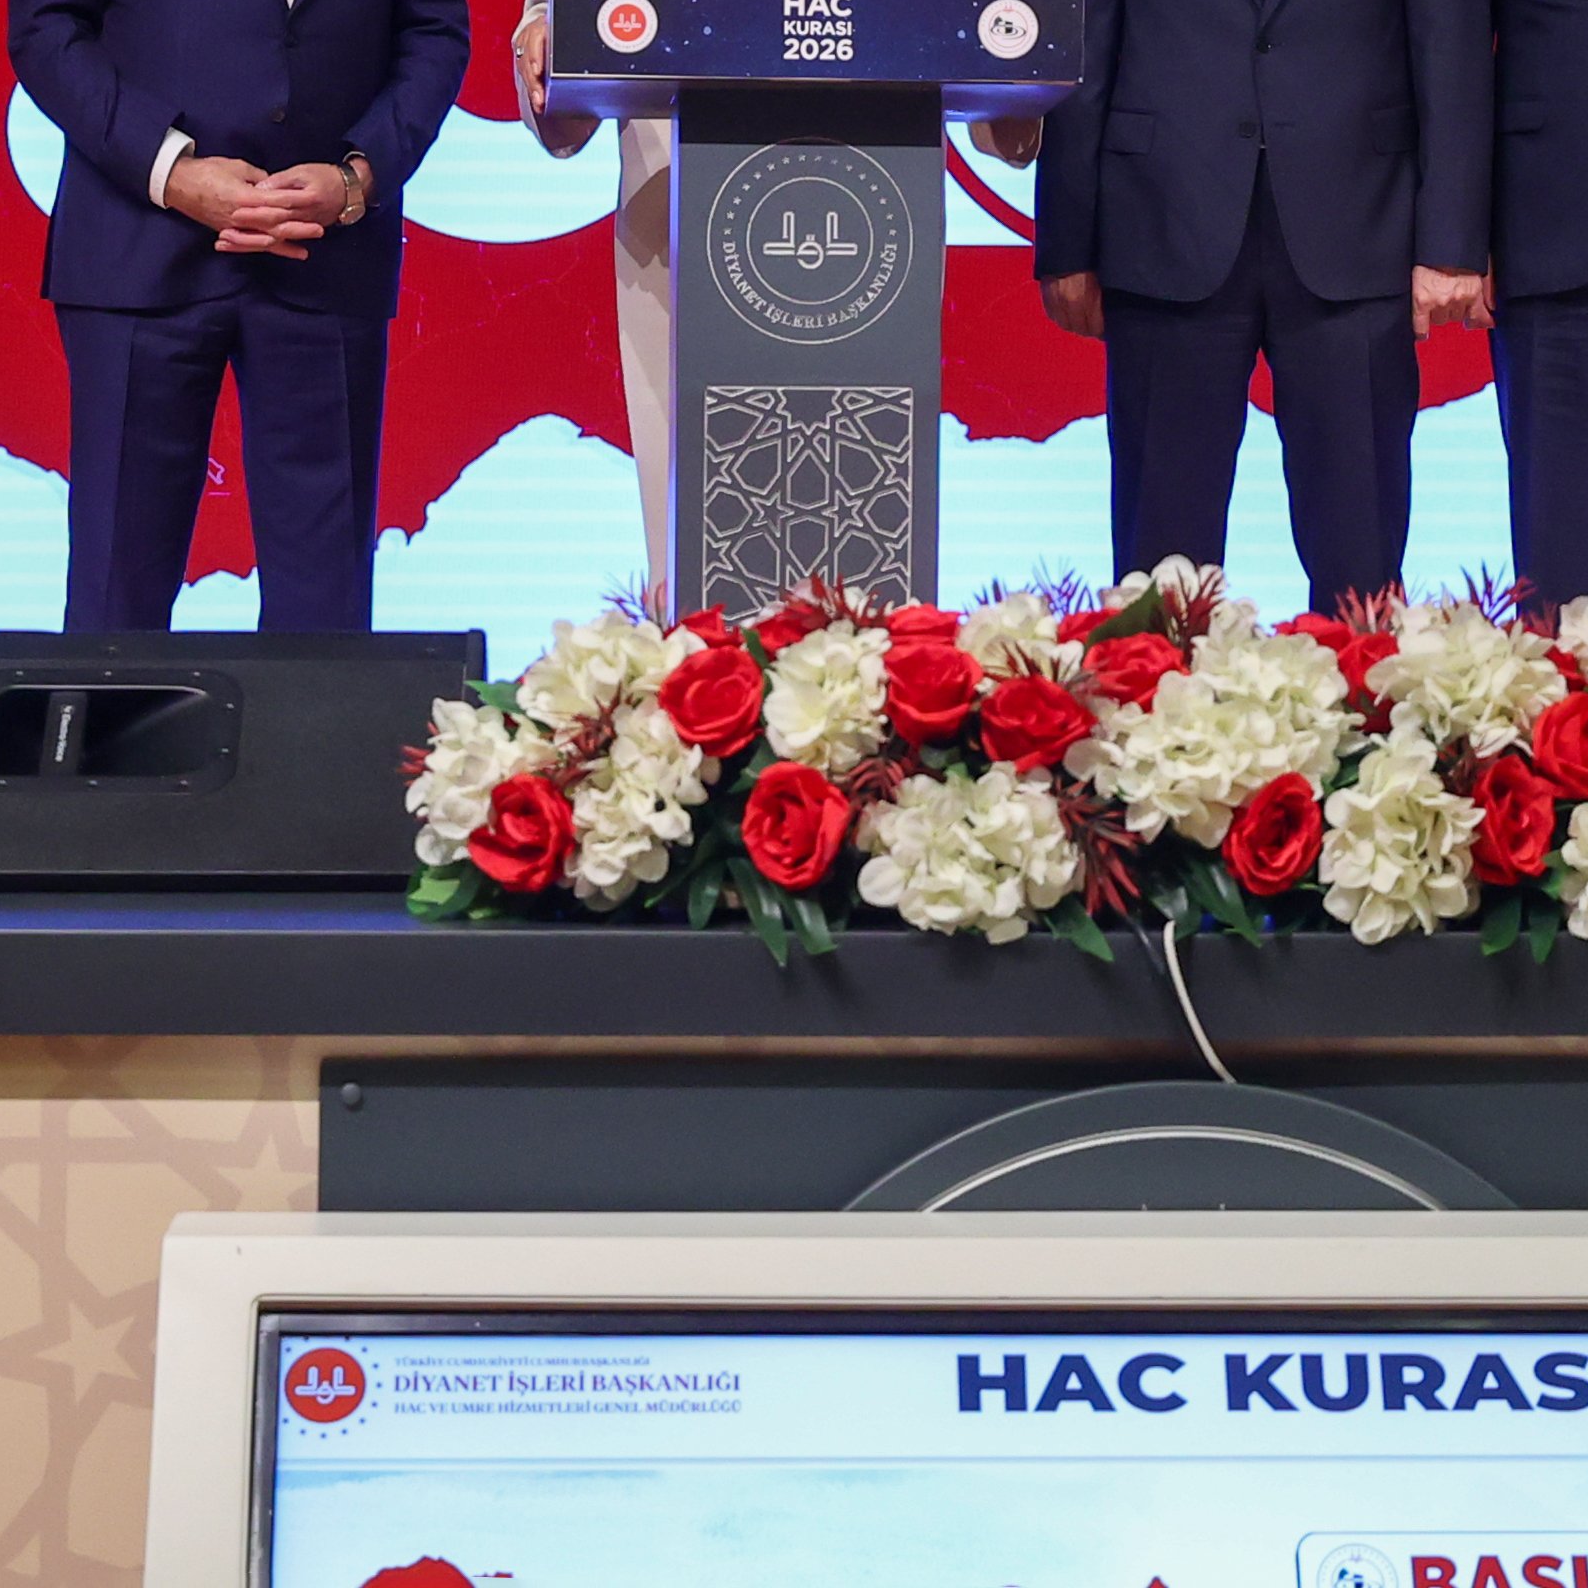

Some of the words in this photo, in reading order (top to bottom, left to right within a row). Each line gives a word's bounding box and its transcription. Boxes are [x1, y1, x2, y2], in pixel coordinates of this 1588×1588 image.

[783, 20, 853, 37] KURASI
[783, 37, 854, 62] 2026
[722, 241, 767, 311] DİYANET
[827, 243, 898, 327] BAŞKANLIĞI
[394, 1370, 503, 1393] DİYANET
[508, 1370, 585, 1397] İŞLERİ
[591, 1370, 742, 1397] BAŞKANLIĞI
[956, 1352, 1189, 1413] HAC
